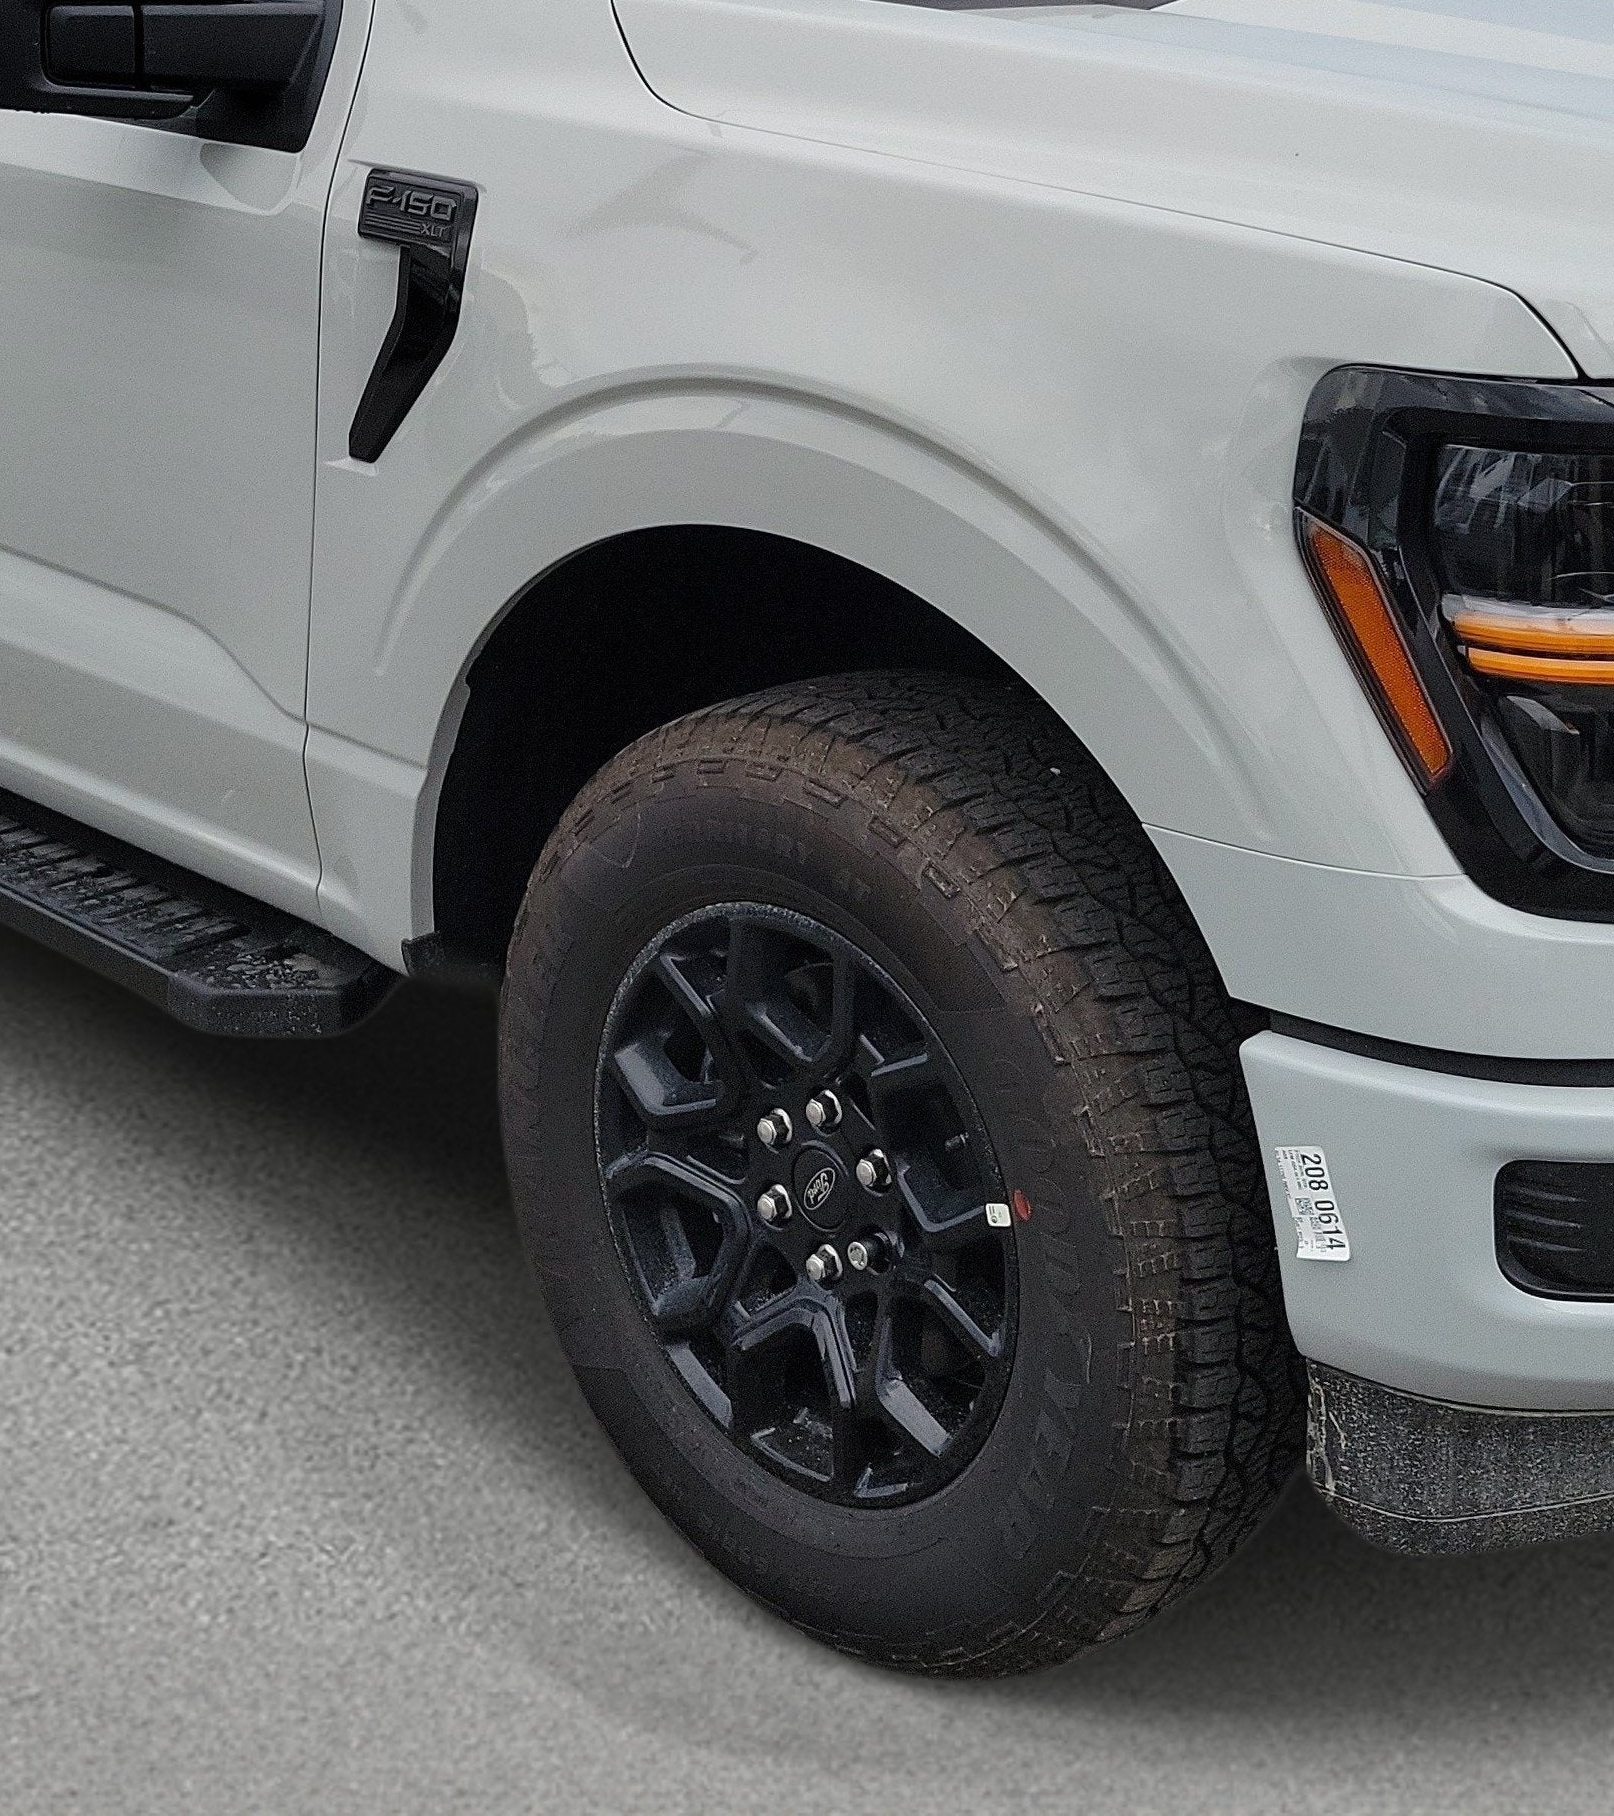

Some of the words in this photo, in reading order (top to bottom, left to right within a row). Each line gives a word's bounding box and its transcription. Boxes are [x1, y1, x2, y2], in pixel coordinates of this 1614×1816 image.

[366, 184, 458, 222] F-150
[419, 223, 450, 238] XLT
[1300, 1153, 1328, 1191] 208
[1314, 1199, 1346, 1250] 0614
